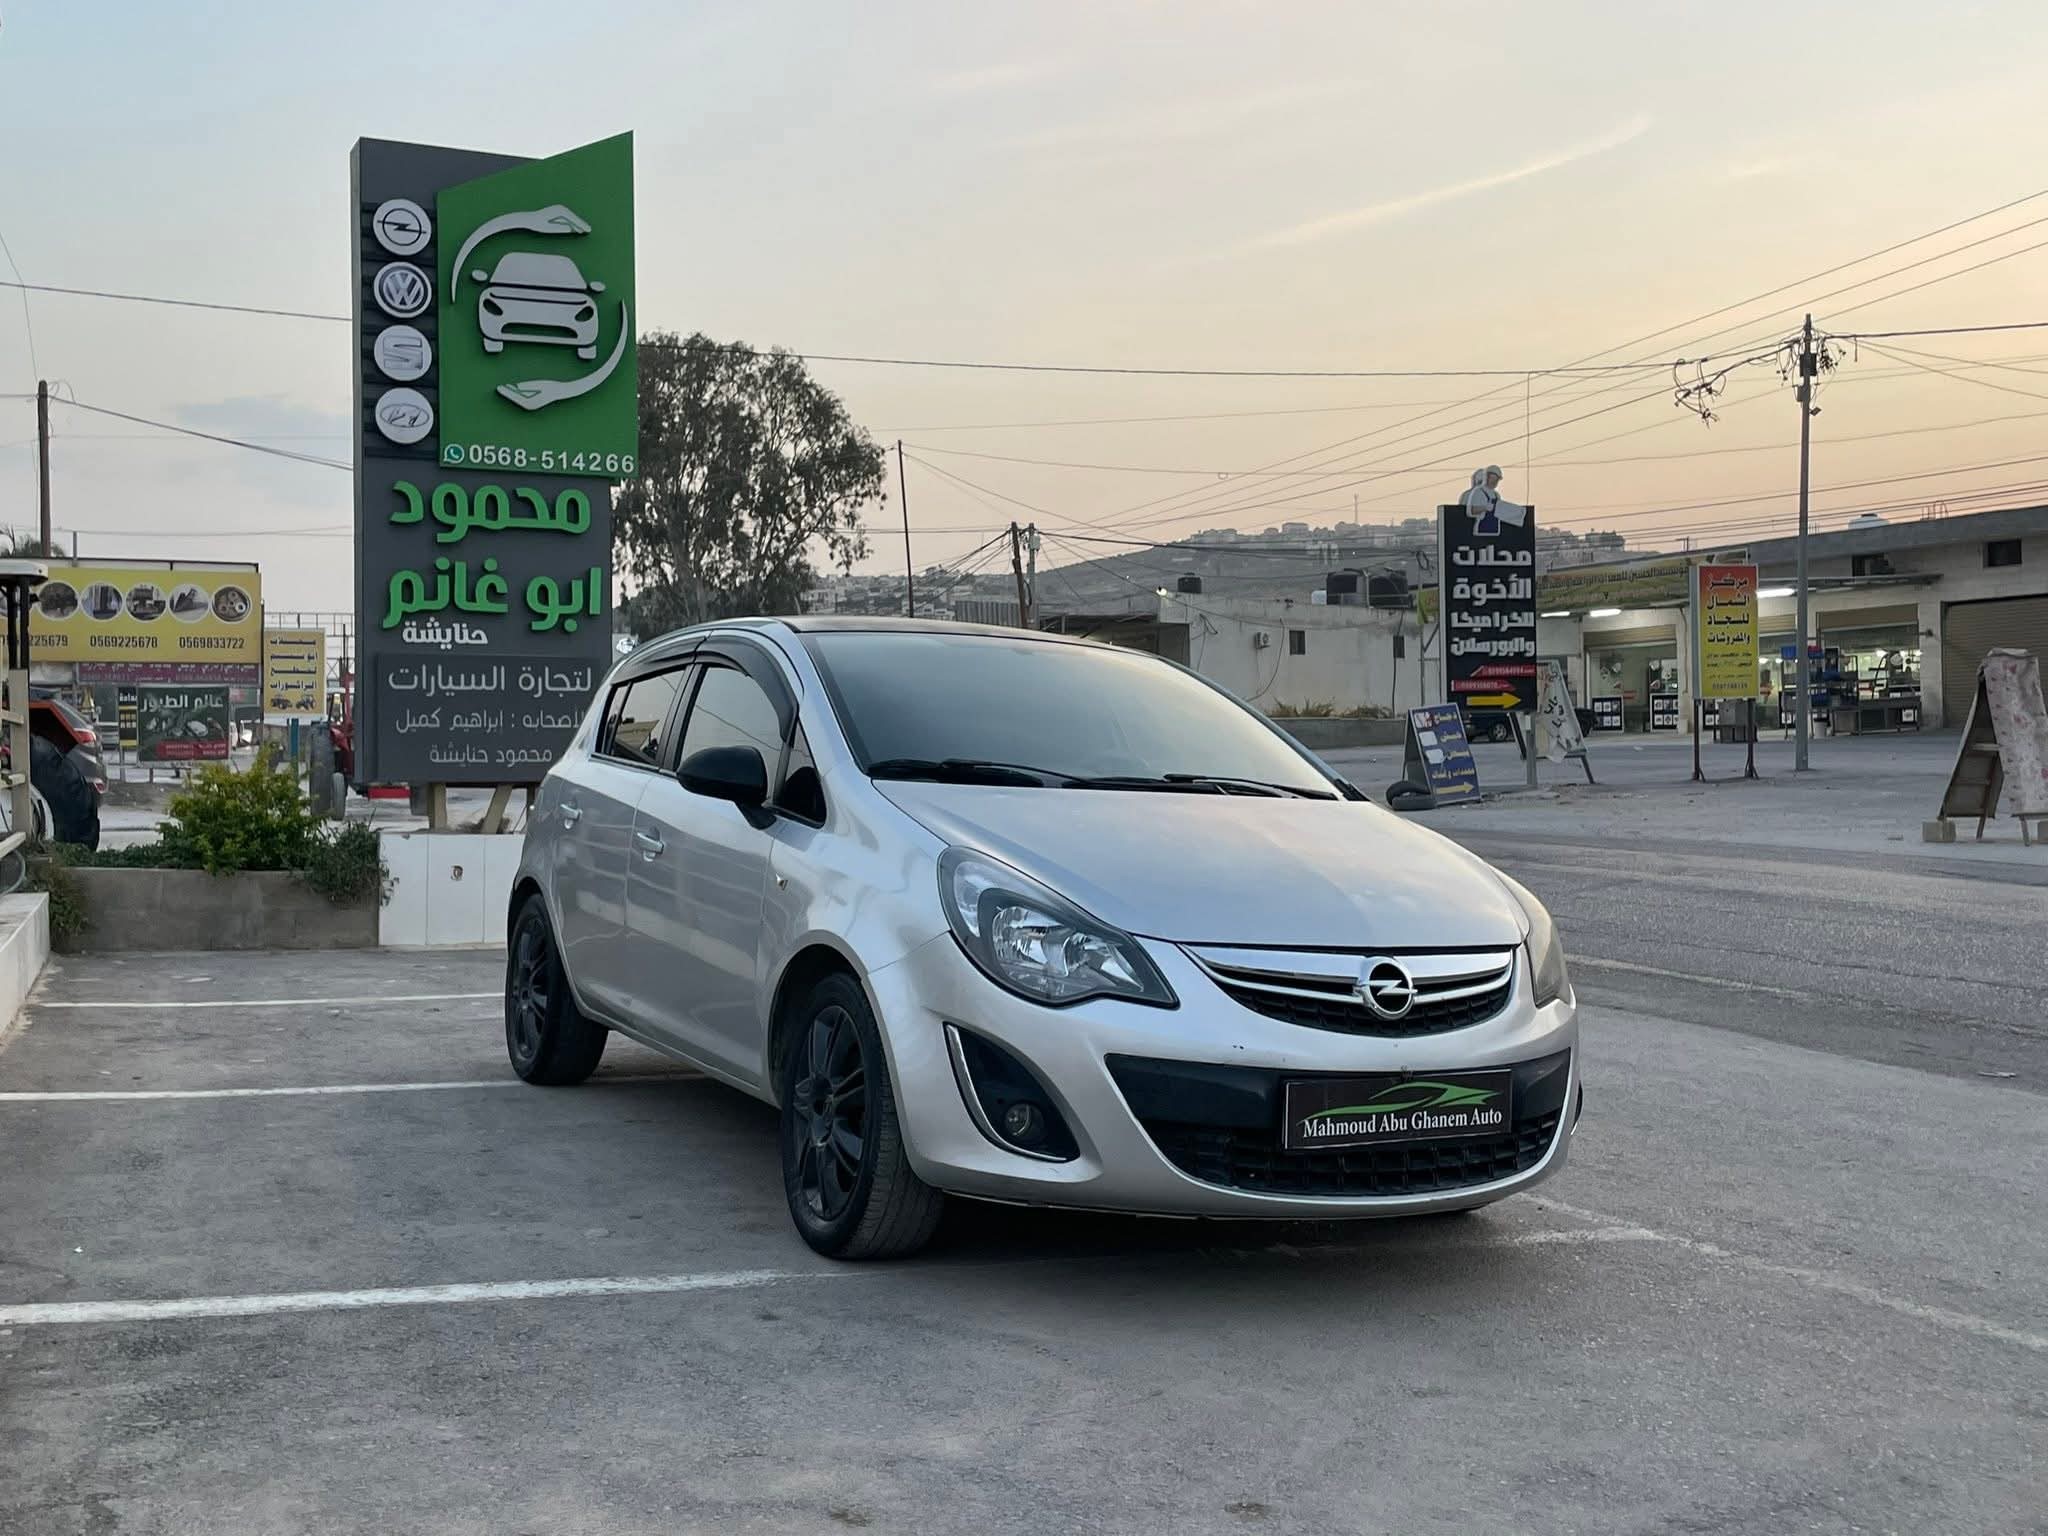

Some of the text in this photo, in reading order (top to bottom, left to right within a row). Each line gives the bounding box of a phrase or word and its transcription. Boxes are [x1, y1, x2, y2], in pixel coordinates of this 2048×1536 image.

[469, 445, 635, 473] 0568-514266
[389, 481, 592, 543] محمود
[1452, 544, 1533, 567] محلات
[383, 557, 602, 632] ابو غانم
[1452, 573, 1532, 606] الأخوة
[1707, 574, 1748, 590] مركز
[1706, 593, 1750, 610] الشمال
[179, 636, 245, 649] 0569833722
[402, 617, 489, 649] حنايشة
[388, 664, 592, 698] لتجارة السيارات
[140, 693, 188, 713] الطيور
[194, 693, 223, 712] عالم
[396, 707, 441, 734] كميل
[450, 708, 503, 734] ابراهيم
[429, 743, 552, 768] محمود حنايشة
[1303, 1107, 1503, 1139] Mahmoud Abu Ghanem Auto
